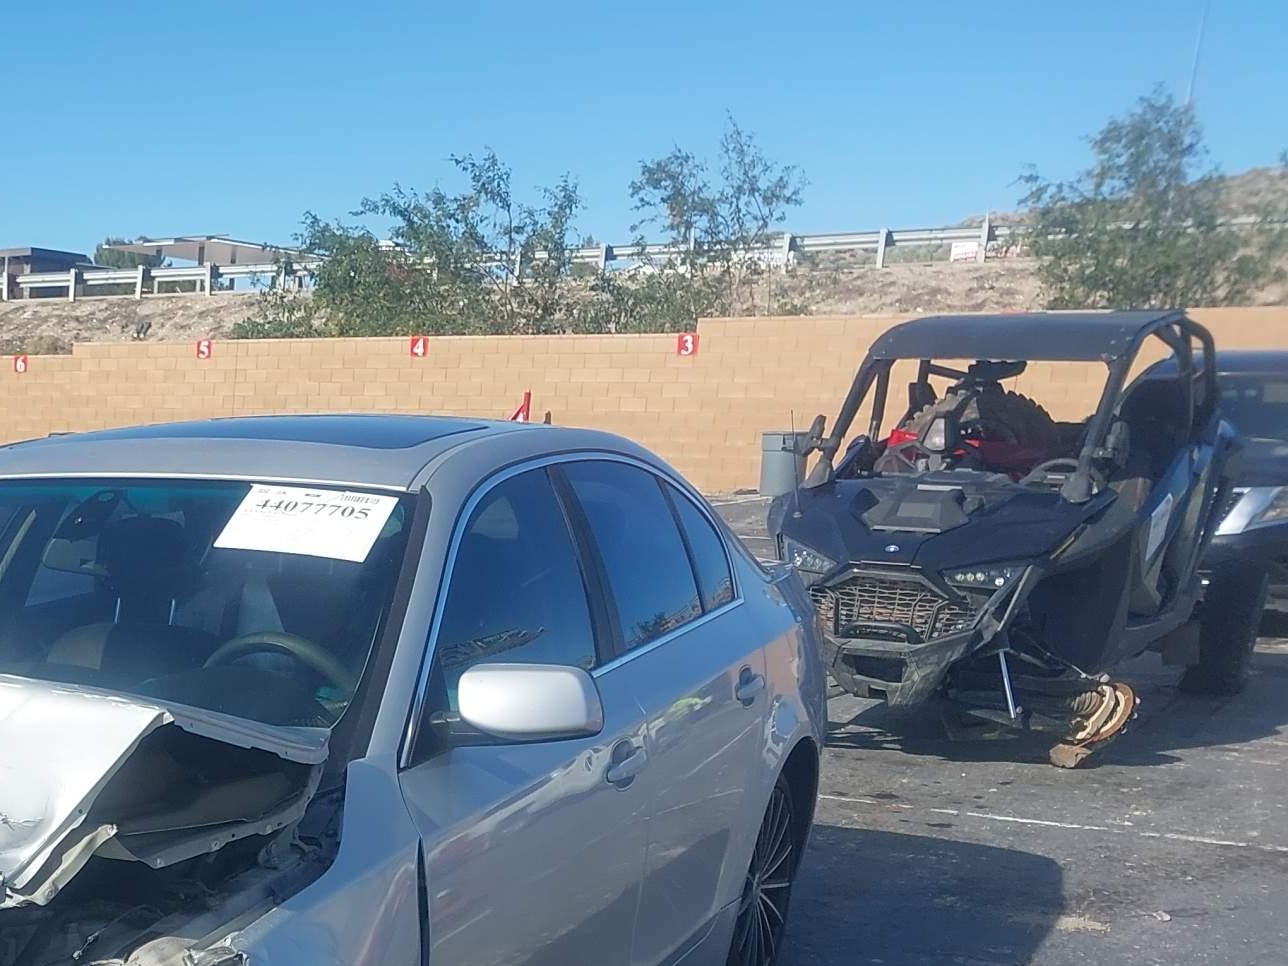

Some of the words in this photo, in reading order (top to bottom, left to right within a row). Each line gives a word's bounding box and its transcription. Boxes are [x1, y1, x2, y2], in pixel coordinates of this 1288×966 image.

[199, 341, 209, 358] 5
[413, 338, 424, 356] 4
[681, 335, 693, 355] 3
[16, 356, 26, 372] 6
[255, 498, 372, 520] 44077705
